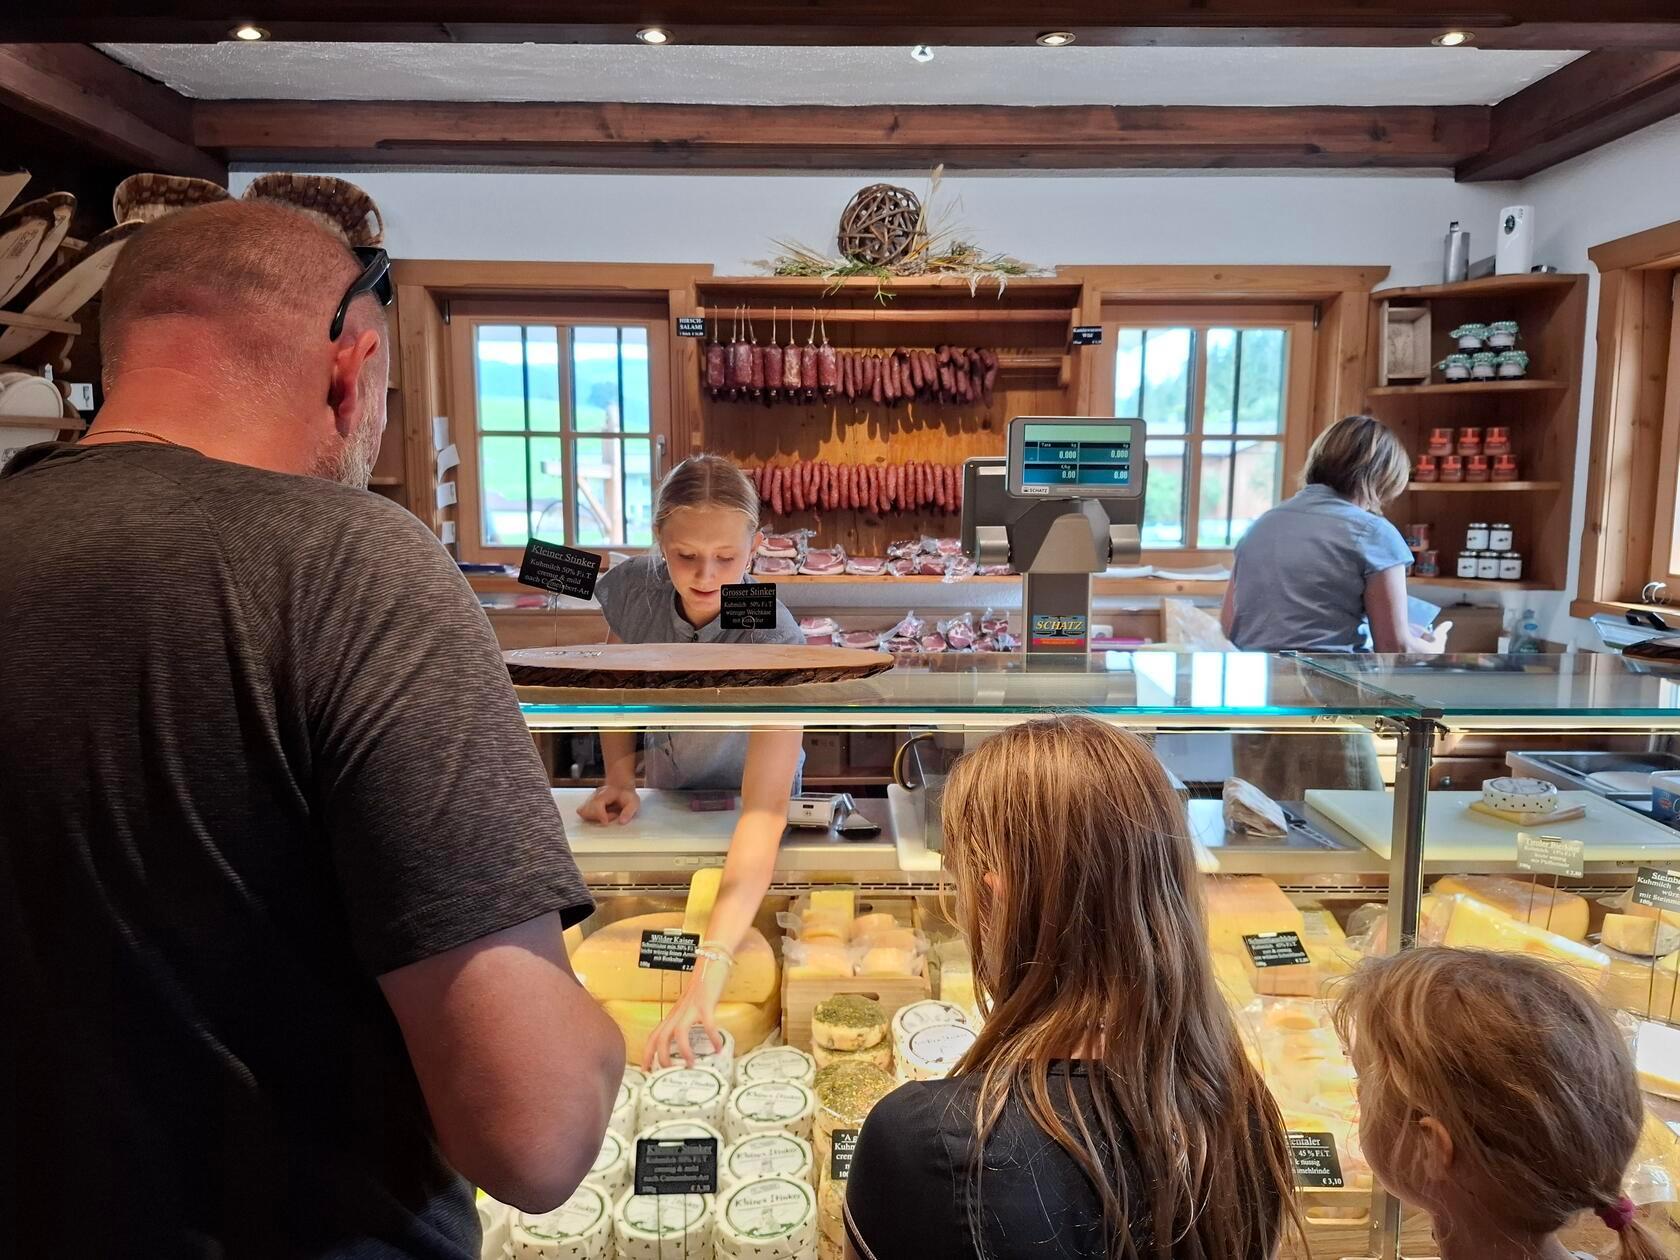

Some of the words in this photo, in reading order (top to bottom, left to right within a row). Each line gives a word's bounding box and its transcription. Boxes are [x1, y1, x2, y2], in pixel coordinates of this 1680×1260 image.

[532, 545, 564, 559] Kleiner
[566, 554, 596, 568] Stinker
[530, 560, 560, 571] Kuhmilch
[722, 588, 748, 596] Grosser
[750, 587, 775, 595] Stinker
[1036, 621, 1083, 630] SCHATZ
[1637, 876, 1671, 889] Kuhmilch
[1290, 1137, 1320, 1145] entaler
